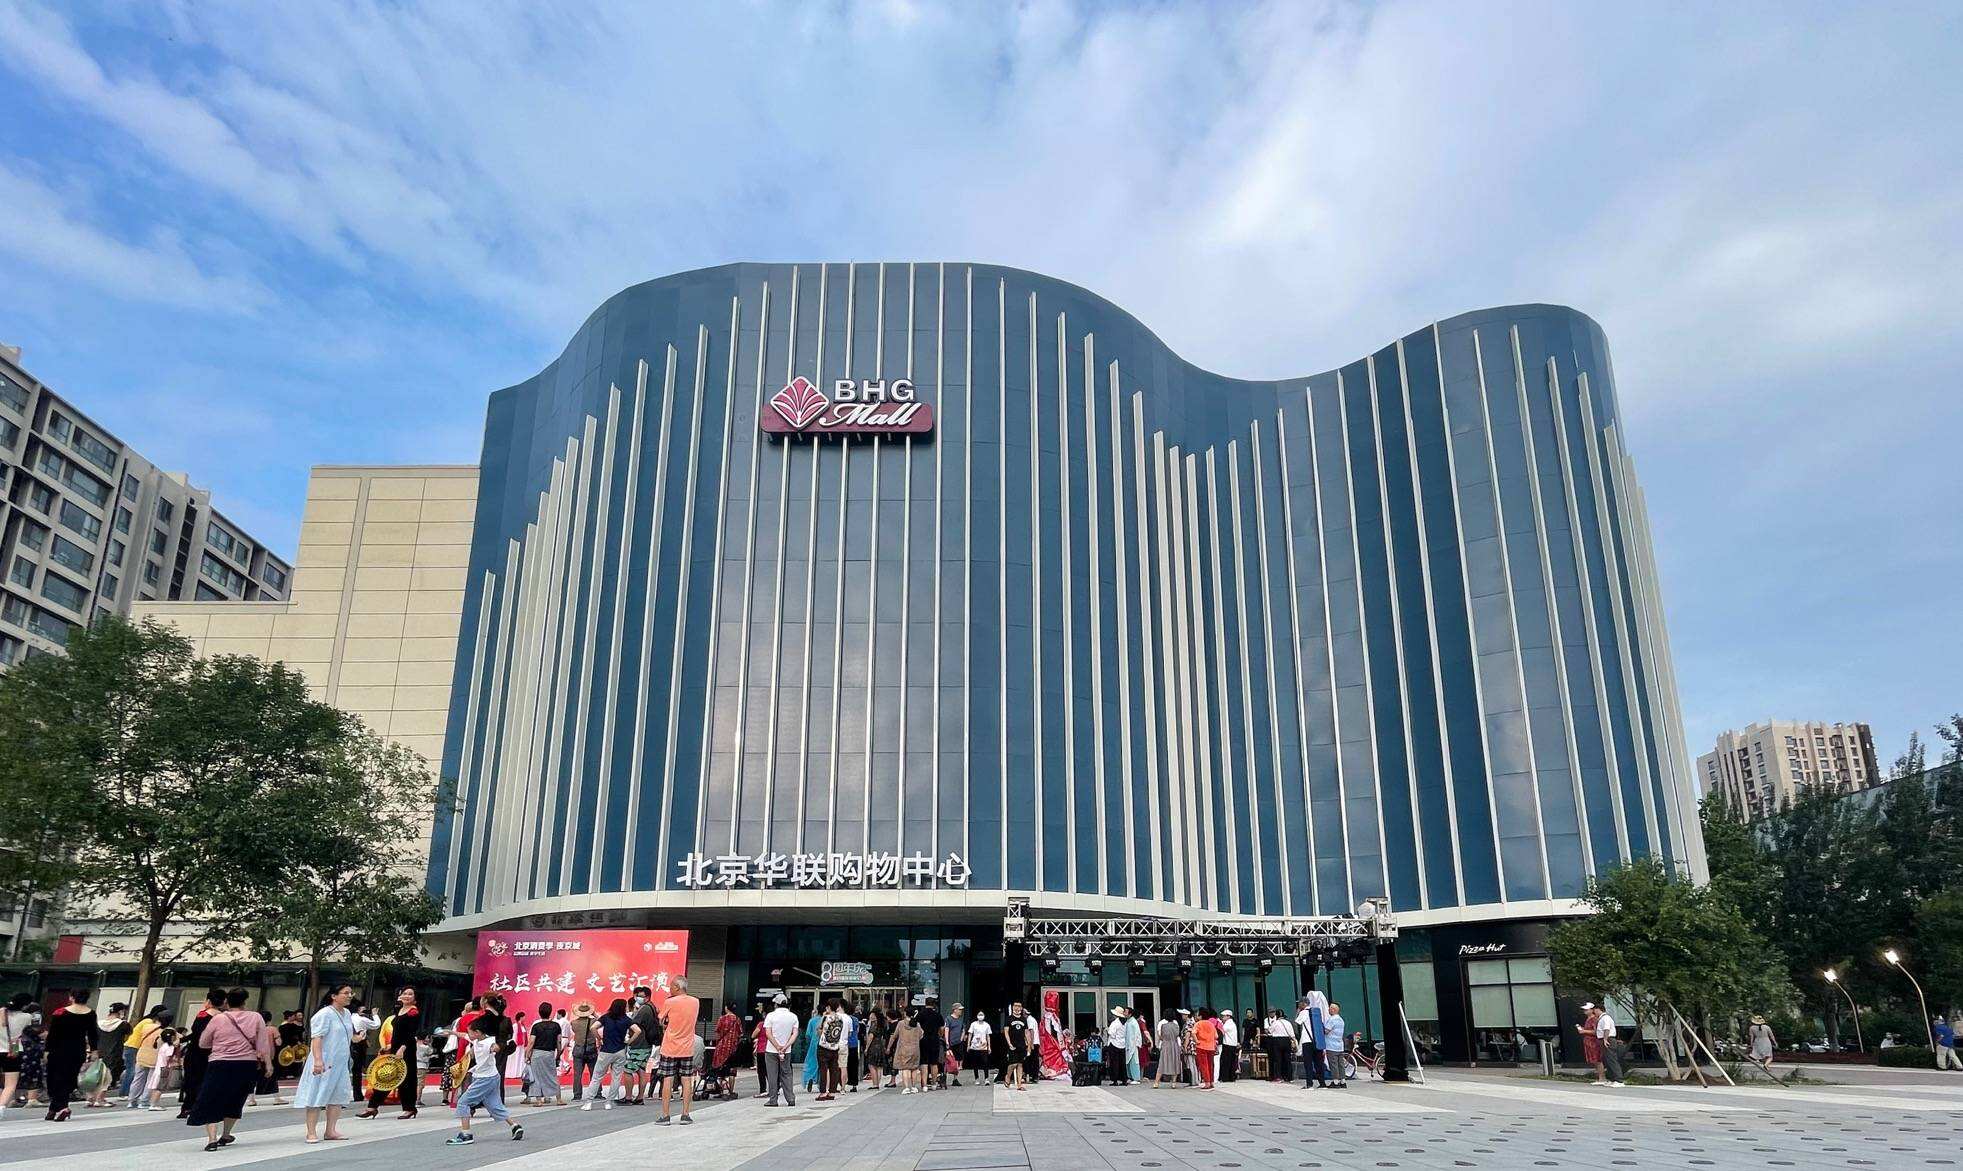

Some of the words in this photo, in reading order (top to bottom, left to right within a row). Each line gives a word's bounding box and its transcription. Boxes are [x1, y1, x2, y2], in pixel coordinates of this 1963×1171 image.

[834, 379, 915, 401] BHG
[819, 402, 922, 426] Mall
[676, 851, 972, 887] 北京华联购物中心
[1458, 944, 1485, 955] Pizza
[1486, 943, 1507, 952] Hut
[489, 971, 576, 995] 社区共建
